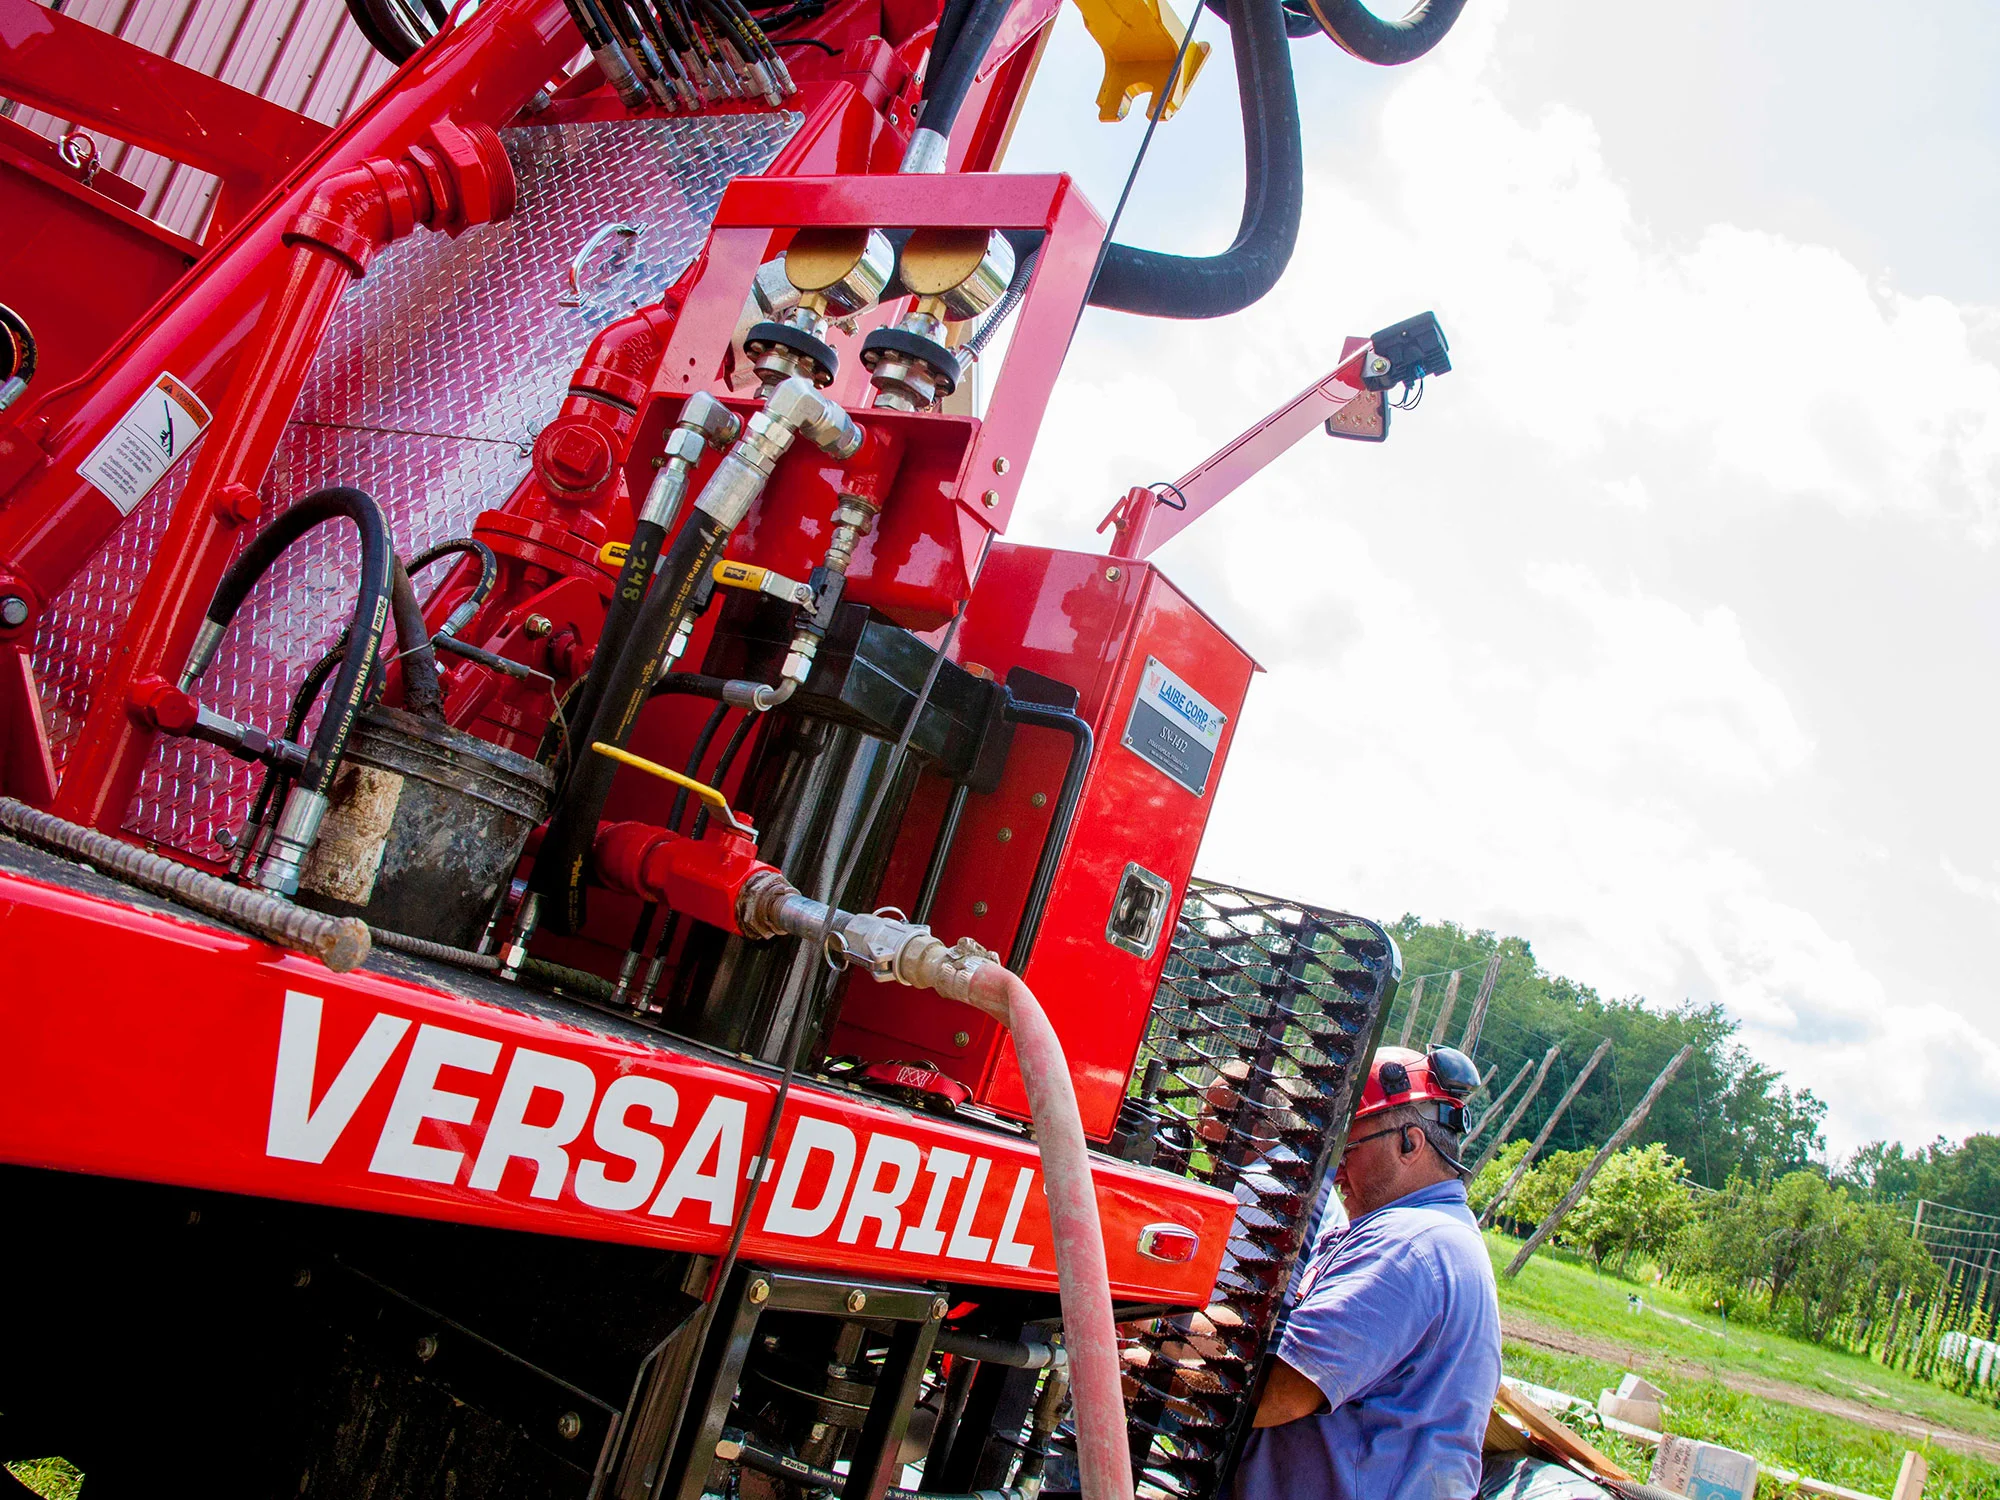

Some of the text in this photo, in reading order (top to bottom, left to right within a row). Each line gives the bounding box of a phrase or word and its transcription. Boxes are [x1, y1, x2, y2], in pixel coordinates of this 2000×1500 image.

[175, 391, 205, 423] WARNING
[373, 596, 388, 632] Parker
[349, 657, 370, 706] TOUGH
[1160, 681, 1186, 708] LAIBE
[1185, 698, 1209, 728] CORP.
[332, 709, 354, 754] 471ST-12
[1160, 726, 1188, 753] SN-1412
[324, 759, 336, 777] WP
[266, 989, 1034, 1267] VERSA-DRILL
[781, 1456, 809, 1474] Parker
